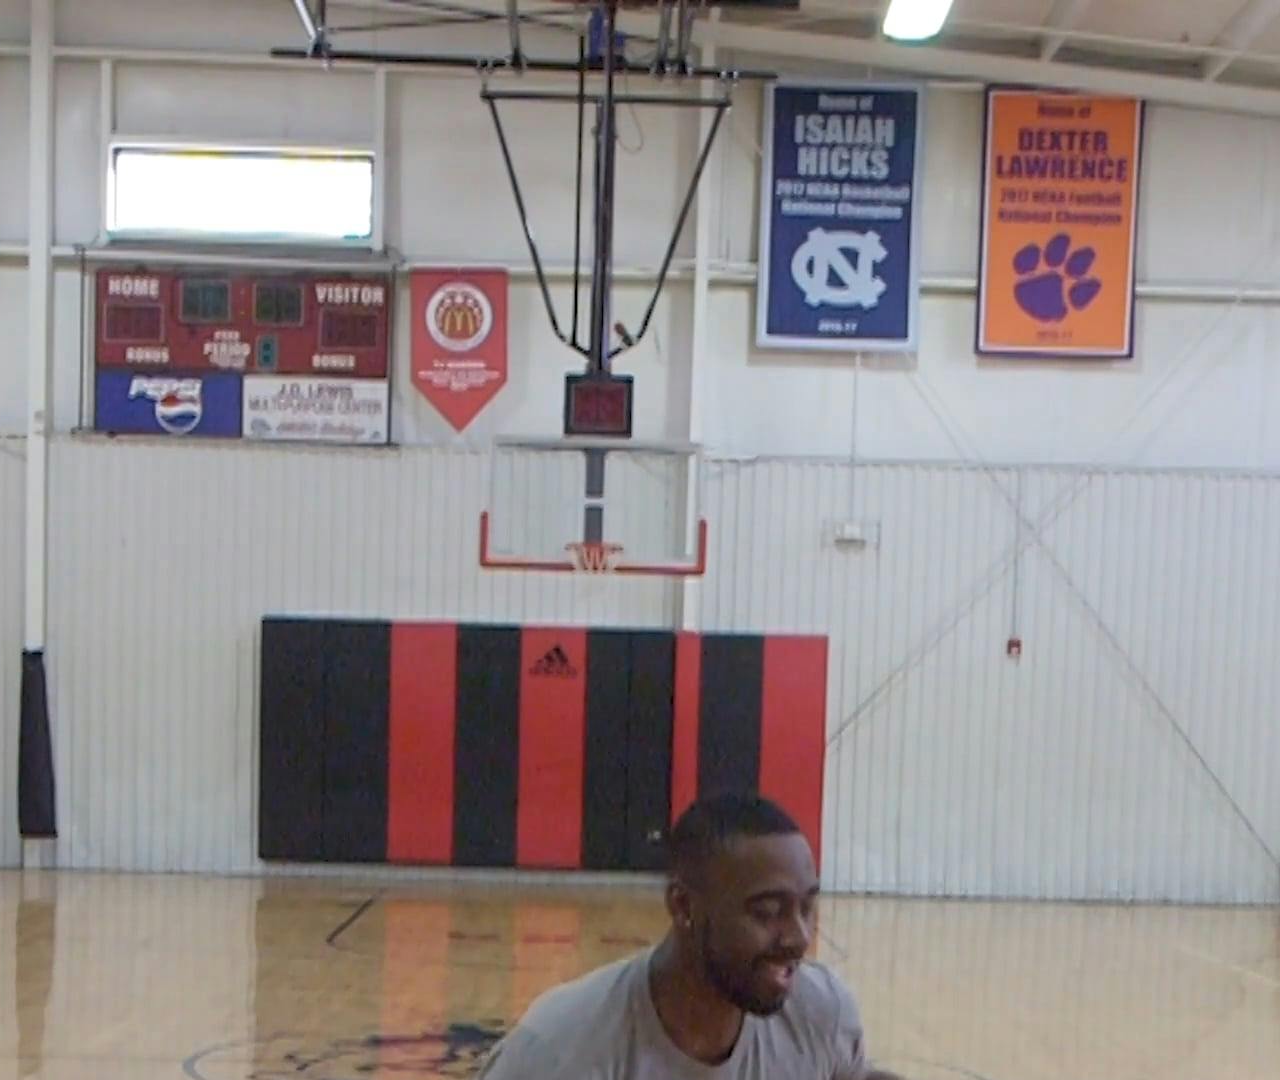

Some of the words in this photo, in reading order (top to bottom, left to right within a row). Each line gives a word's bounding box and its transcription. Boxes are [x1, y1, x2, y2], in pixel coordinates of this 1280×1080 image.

[794, 114, 895, 147] ISAIAH
[1018, 128, 1108, 153] DEXTER
[797, 146, 889, 179] HICKS
[996, 155, 1128, 182] LAWRENCE
[109, 276, 159, 297] HOME
[316, 284, 384, 305] VISITOR
[126, 347, 168, 362] BONUS
[313, 355, 354, 368] BONUS
